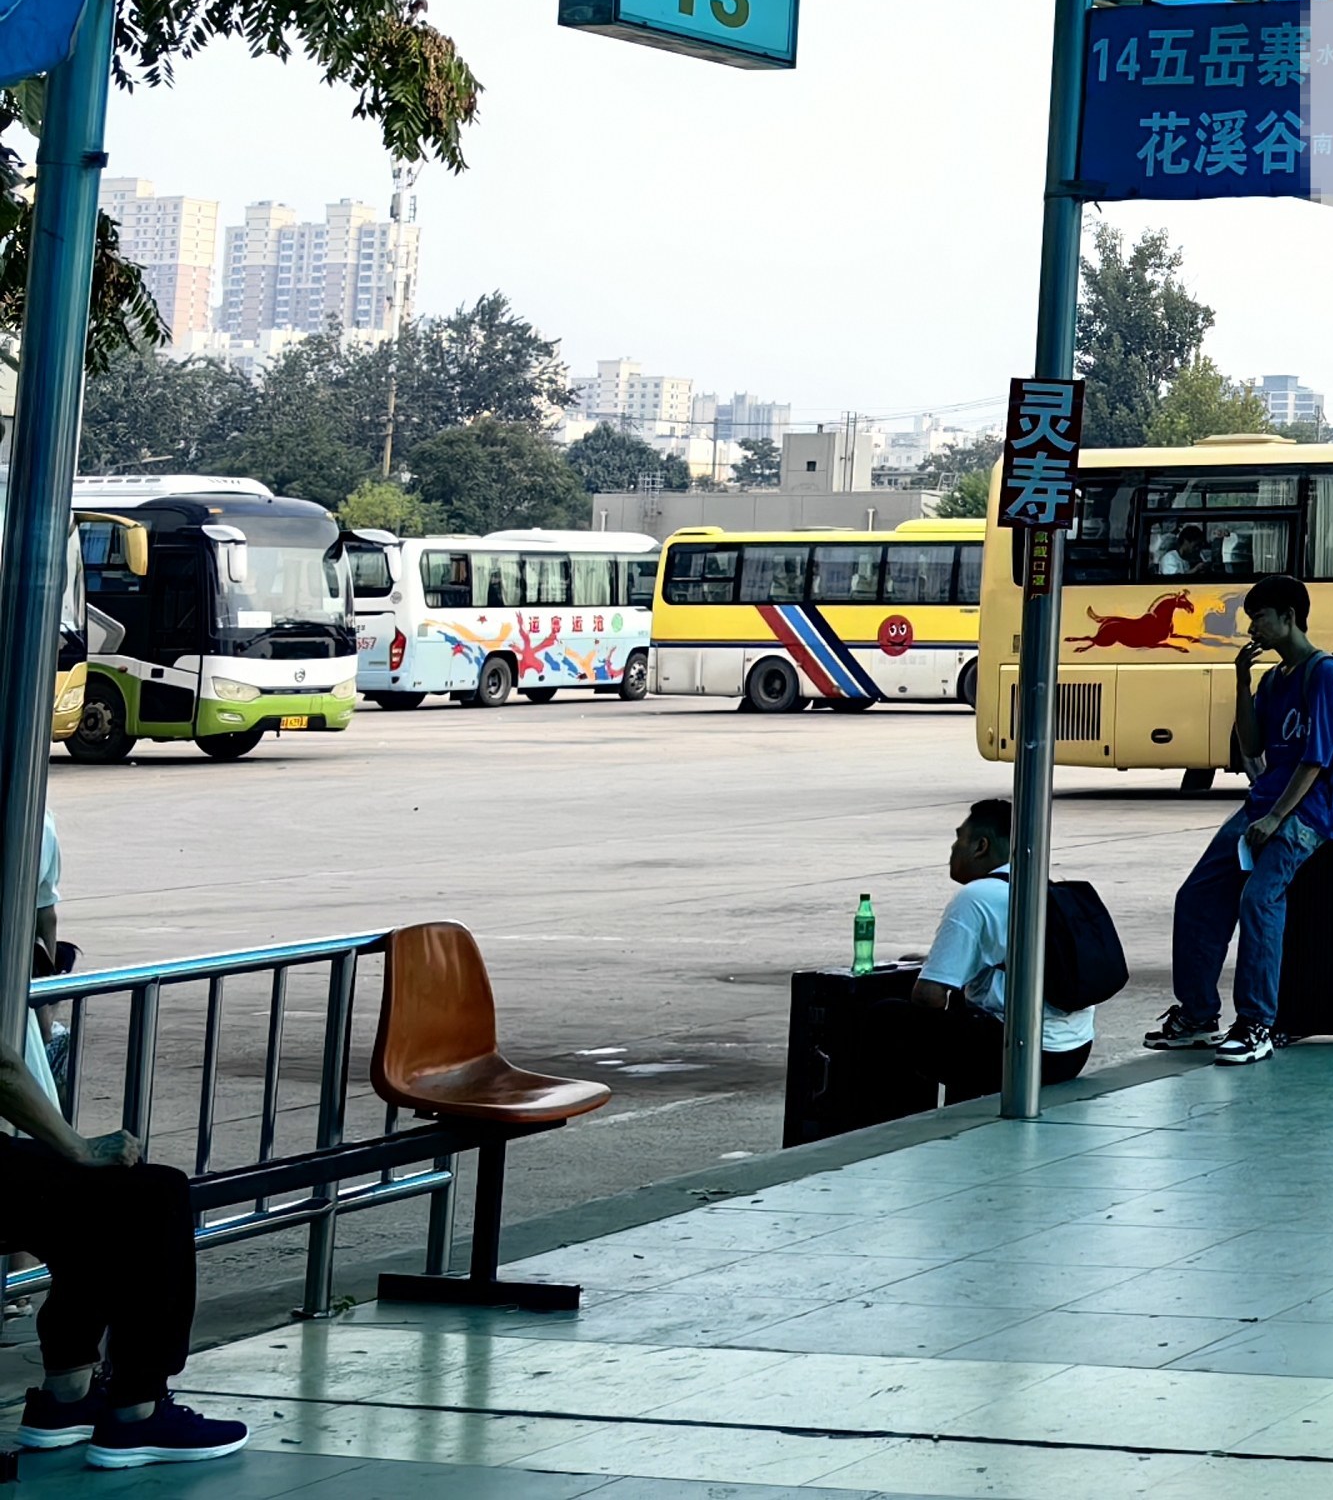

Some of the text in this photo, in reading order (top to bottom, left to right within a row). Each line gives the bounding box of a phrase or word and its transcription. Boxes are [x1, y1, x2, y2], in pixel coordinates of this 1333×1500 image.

[1137, 110, 1308, 178] 花溪谷
[1005, 382, 1077, 524] 灵寿
